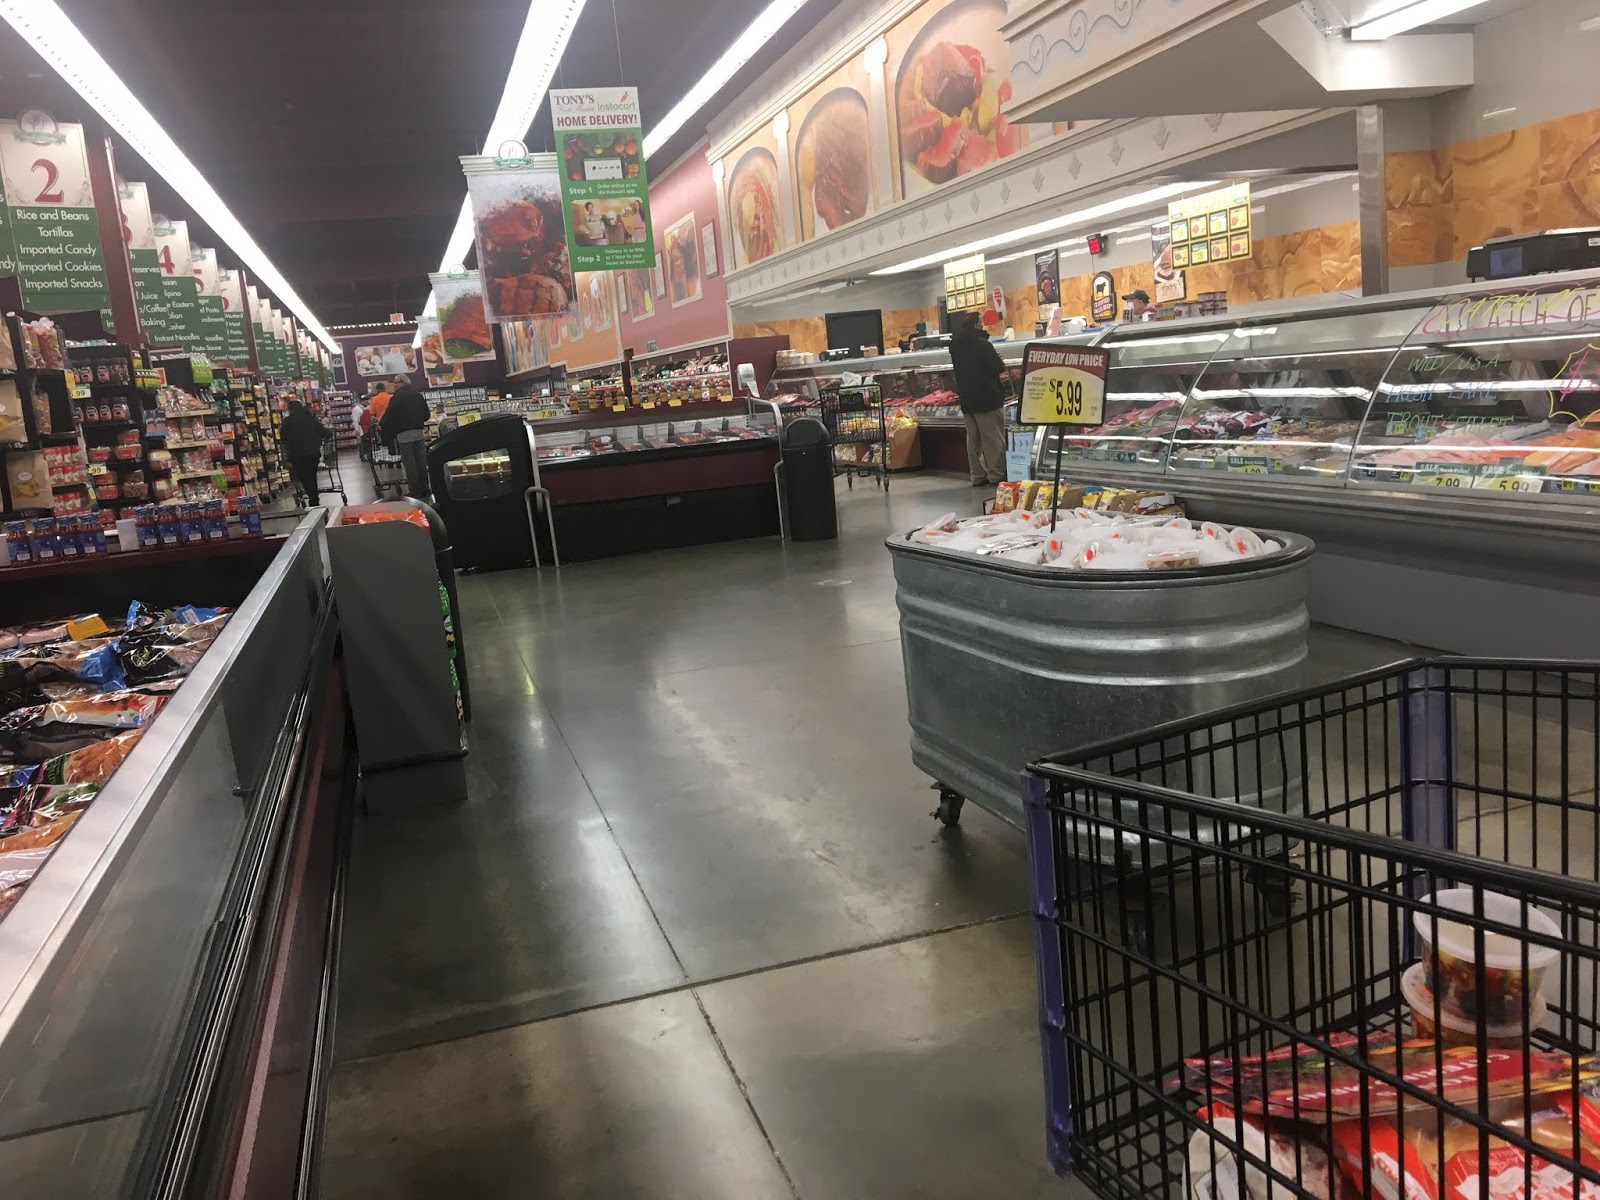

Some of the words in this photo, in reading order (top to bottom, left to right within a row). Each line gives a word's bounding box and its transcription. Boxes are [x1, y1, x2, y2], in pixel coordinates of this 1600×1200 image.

[554, 94, 595, 105] TONY'S
[556, 116, 587, 127] HOME
[589, 114, 638, 126] DELIVERY!
[31, 158, 64, 204] 2
[568, 187, 587, 195] Step
[16, 209, 37, 220] Rice
[39, 209, 58, 220] and
[60, 210, 89, 221] Beans
[37, 226, 74, 238] Tortillas
[19, 243, 63, 257] Imported
[64, 243, 97, 257] Candy
[0, 254, 16, 273] ndy
[158, 245, 175, 275] 4
[577, 255, 595, 263] Step
[19, 260, 63, 274] Imported
[64, 260, 102, 272] Cookies
[131, 266, 160, 274] reserves
[24, 277, 68, 291] Imported
[69, 276, 104, 289] Snacks
[140, 291, 159, 300] Juice
[140, 317, 166, 328] Baking
[1027, 350, 1065, 364] EVERYDAY
[1065, 353, 1079, 365] LOW
[1079, 354, 1104, 367] PRICE
[1048, 377, 1082, 416] $5.99
[1387, 411, 1444, 434] TROUT
